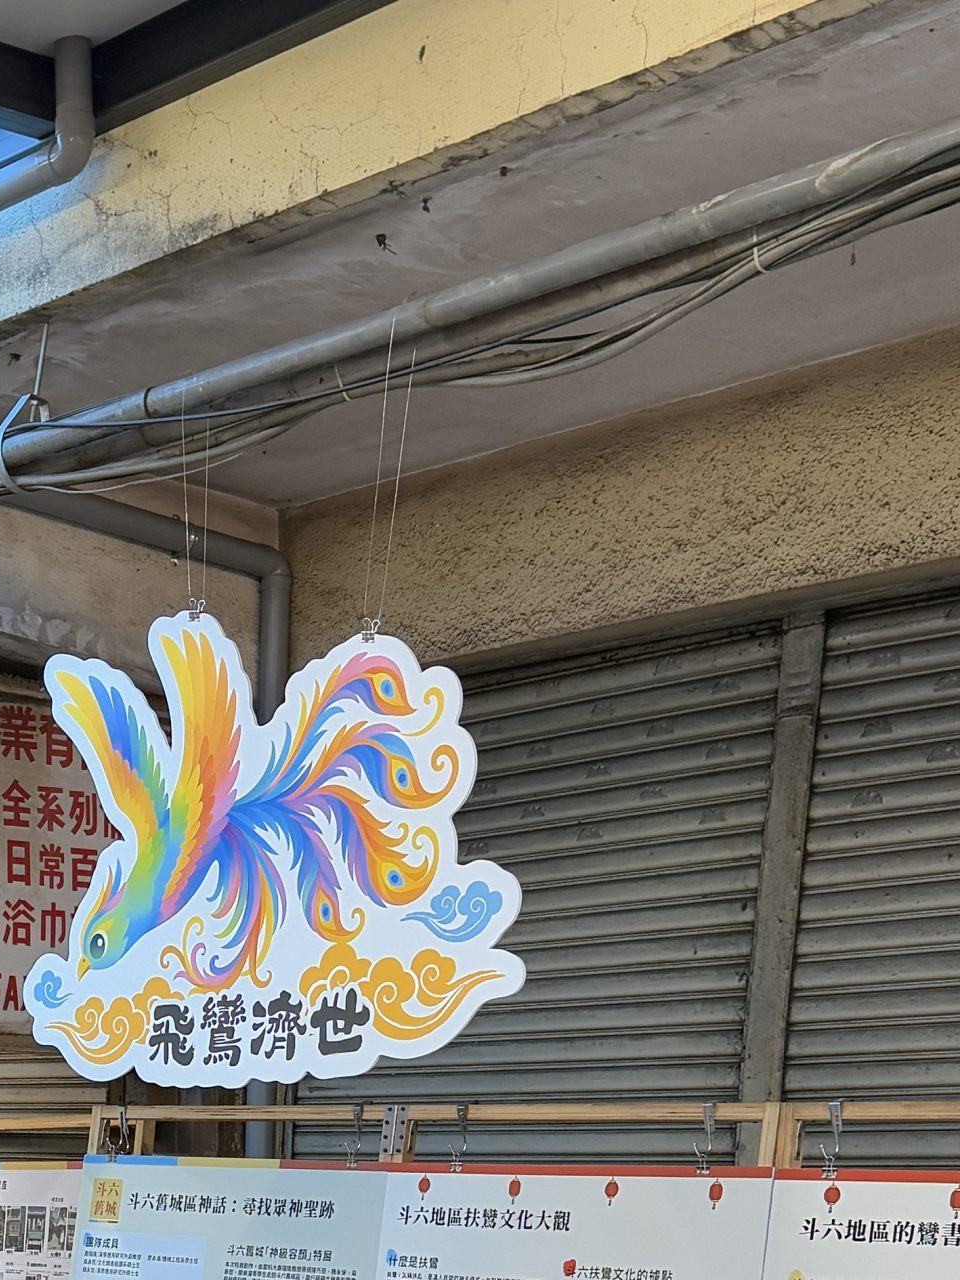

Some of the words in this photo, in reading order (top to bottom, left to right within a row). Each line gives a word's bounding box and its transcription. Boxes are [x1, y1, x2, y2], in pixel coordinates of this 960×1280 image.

[149, 988, 370, 1066] 飛鸞濟世
[397, 1205, 571, 1231] 斗六地區扶鸞文化大觀
